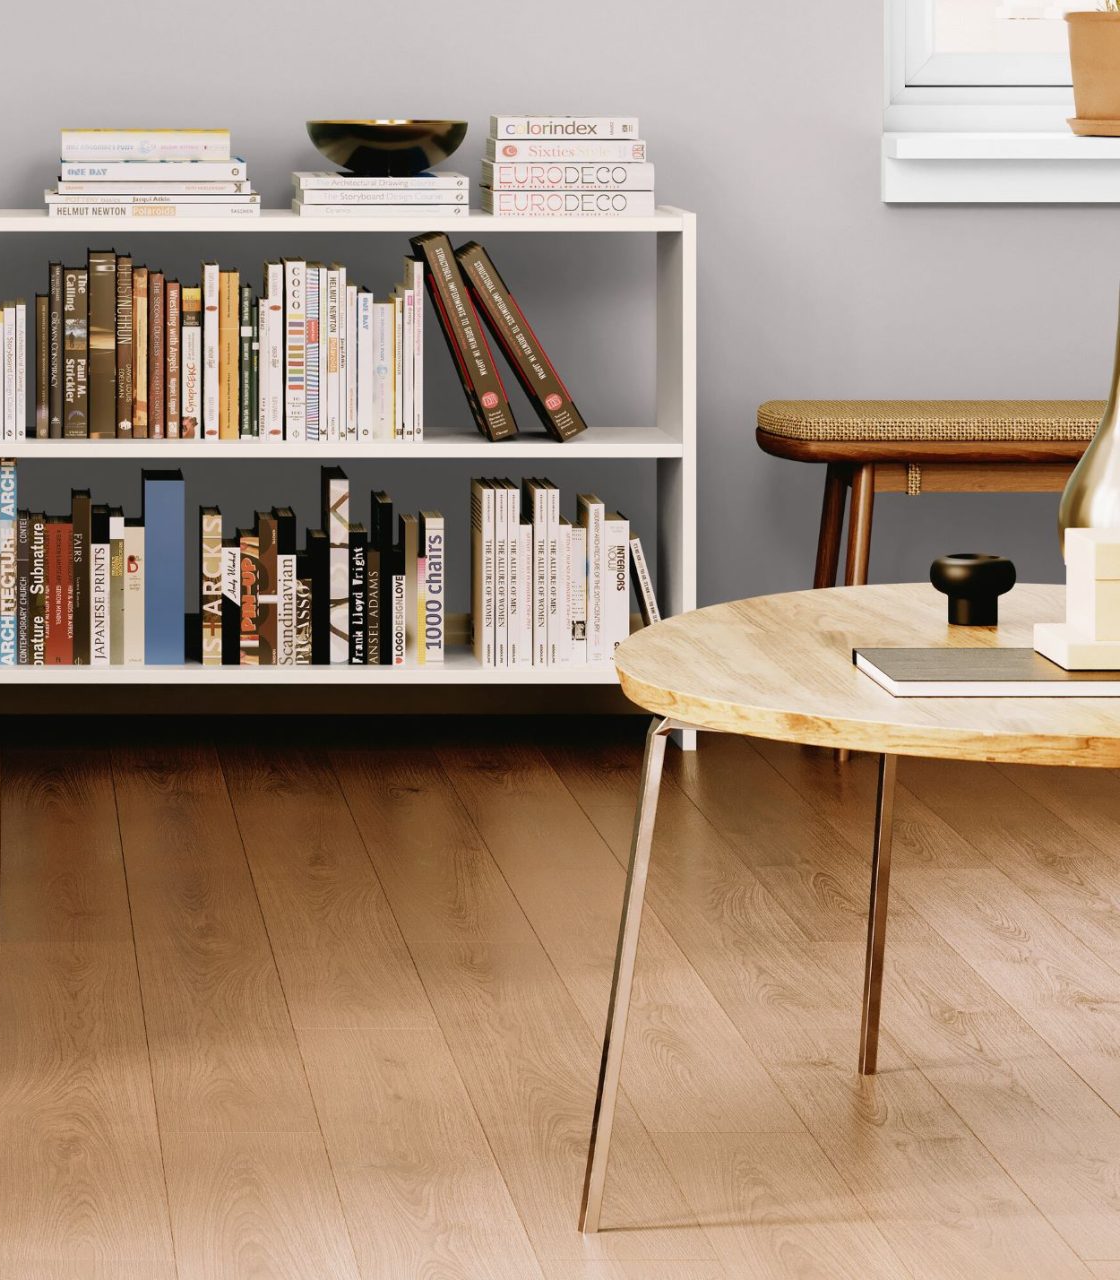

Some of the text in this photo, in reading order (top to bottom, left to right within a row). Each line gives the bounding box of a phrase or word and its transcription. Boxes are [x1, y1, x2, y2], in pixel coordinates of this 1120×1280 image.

[505, 121, 597, 135] colorindex
[528, 146, 576, 158] Sixties
[67, 168, 108, 176] ONE DAY
[331, 179, 409, 188] Architectural Drawing
[499, 166, 627, 184] EURODECO
[57, 206, 89, 216] HELMUT
[92, 206, 127, 216] NEWTON
[340, 192, 384, 202] Storyboard
[499, 194, 627, 211] EURODECO
[435, 247, 451, 282] STRUCTURAL
[65, 274, 76, 311] Calling
[78, 274, 87, 294] The
[153, 282, 161, 295] THE
[292, 267, 300, 310] COCO
[448, 280, 467, 318] IMPEDIMENTS
[116, 264, 132, 344] GEOSYNCHRON
[167, 289, 178, 326] Wrestling
[461, 316, 469, 326] TO
[474, 260, 495, 294] STRUCTURAL
[491, 292, 516, 327] IMPEDIMENTS
[515, 331, 533, 357] GROWTH
[531, 361, 547, 380] JAPAN
[153, 325, 161, 356] DUCHESS
[167, 332, 178, 346] with
[464, 326, 477, 354] GROWTH
[167, 346, 178, 373] Angels
[475, 358, 488, 377] JAPAN
[66, 359, 76, 403] Strickler
[77, 359, 86, 398] Paul M.
[19, 518, 27, 544] CONTE
[1, 458, 15, 665] ARCHITECTURE ARCHI
[30, 523, 44, 595] Subnature
[74, 533, 83, 563] FAIRS
[228, 551, 238, 599] Andy Warhol
[617, 545, 625, 591] INTERIORS
[94, 547, 107, 659] JAPANESE PRINTS
[240, 557, 257, 633] PIN-UP
[352, 546, 365, 664] Frank Lloyd Wright
[425, 535, 442, 650] 1000 chairs
[485, 586, 492, 597] OF
[498, 586, 505, 597] OF
[510, 586, 517, 597] OF
[538, 586, 545, 597] OF
[550, 586, 557, 597] OF
[19, 577, 27, 664] CONTEMPORARY CHURCH
[279, 558, 293, 665] Scandinavian
[294, 580, 310, 664] PICASSO
[368, 571, 378, 664] ANSEL ADAMS
[395, 576, 403, 657] LOGODESIGNLOVE
